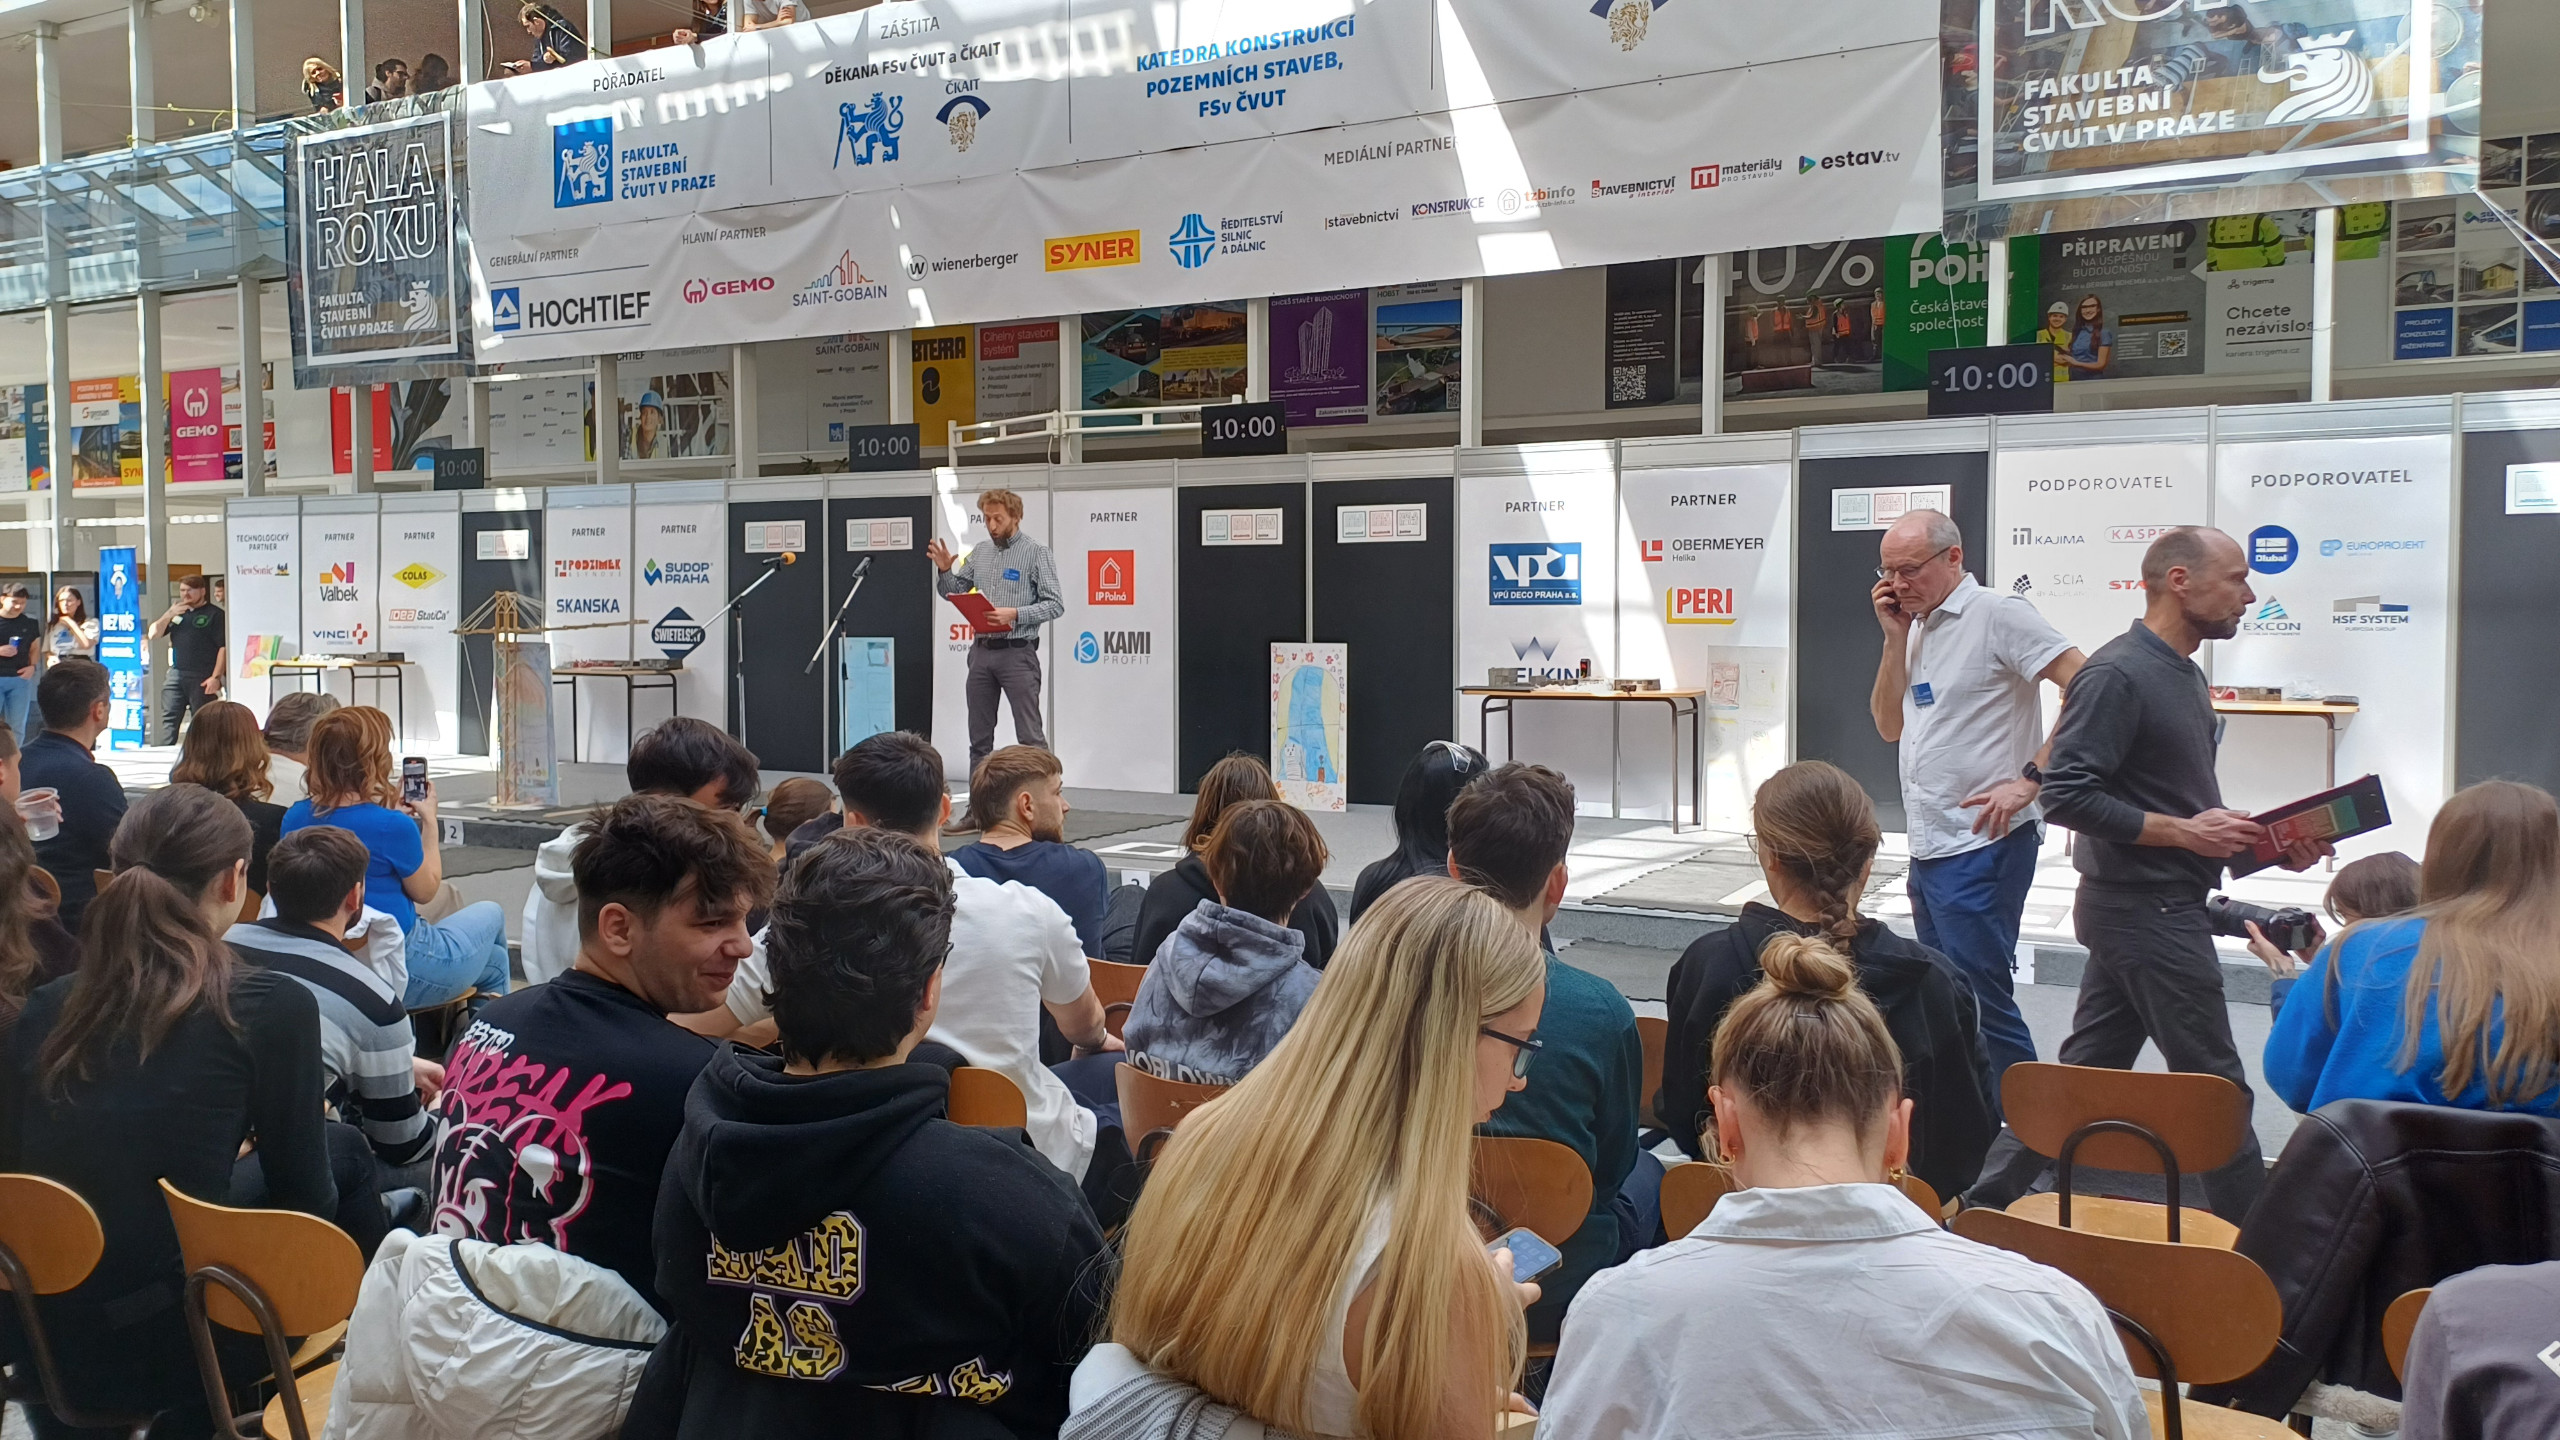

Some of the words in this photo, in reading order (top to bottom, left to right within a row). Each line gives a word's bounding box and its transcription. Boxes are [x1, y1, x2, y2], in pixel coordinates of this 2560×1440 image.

[880, 16, 940, 40] ZÁŠTITA
[1137, 42, 1221, 72] KATEDRA
[1225, 15, 1356, 55] KONSTRUKCÍ
[825, 63, 879, 85] DĚKANA
[882, 59, 907, 75] FSv
[910, 49, 946, 70] ČVUT
[949, 53, 957, 63] a
[960, 42, 1001, 62] ČKAIT
[593, 66, 666, 92] POŘADATEL
[1147, 64, 1258, 98] POZEMNÍCH
[1264, 51, 1343, 79] STAVEB,
[945, 77, 980, 95] ČKAIT
[2024, 65, 2153, 101] FAKULTA
[1199, 99, 1231, 117] FSv
[1235, 89, 1286, 112] ČVUT
[2023, 84, 2172, 127] STAVEBNÍ
[2022, 124, 2099, 153] ČVUT
[2105, 124, 2126, 145] V
[2135, 109, 2236, 138] PRAZE
[621, 143, 678, 164] FAKULTA
[1324, 141, 1392, 166] MEDIÁLNÍ
[1821, 149, 1900, 170] estav.tv
[621, 158, 687, 182] STAVEBNÍ
[1722, 158, 1783, 175] materiály
[315, 142, 434, 212] HALA
[621, 180, 656, 200] ČVUT
[660, 180, 669, 194] V
[672, 174, 716, 193] PRAZE
[1524, 186, 1575, 202] tzbinfo
[1592, 176, 1676, 198] STAVEBNICTVÍ
[1412, 197, 1485, 216] KONSTRUKCE
[1220, 211, 1283, 231] ŘEDITELSTVÍ
[1328, 208, 1400, 228] stavebnictví
[316, 202, 436, 270] ROKU
[682, 229, 718, 245] HLAVNÍ
[720, 226, 766, 242] PARTNER
[1221, 230, 1252, 243] SILNIC
[1050, 237, 1134, 265] SYNER
[1221, 245, 1228, 255] A
[1230, 240, 1266, 253] DÁLNIC
[489, 249, 539, 268] GENERÁLNÍ
[539, 248, 579, 262] PARTNER
[932, 252, 1019, 273] wienerberger
[2081, 258, 2096, 267] NA
[1909, 254, 2014, 289] POH
[2073, 263, 2149, 278] BUDOUCNOST
[711, 276, 775, 296] GEMO
[2242, 277, 2274, 286] trigema
[319, 292, 364, 308] FAKULTA
[793, 285, 887, 307] SAINT-GOBAIN
[1271, 297, 1291, 307] CHCEŠ
[319, 304, 371, 324] STAVEBNÍ
[529, 291, 651, 328] HOCHTIEF
[1910, 299, 1949, 314] Česká
[2227, 305, 2291, 320] Chcete
[1910, 315, 1984, 333] společnost
[2226, 320, 2314, 337] nezávislos
[2404, 318, 2442, 326] PROJEKTY
[321, 323, 347, 340] ČVUT
[349, 324, 356, 336] V
[359, 320, 394, 335] PRAZE
[983, 330, 1015, 343] Cihelný
[1017, 327, 1054, 340] stavební
[616, 351, 645, 361] CHTIEF
[815, 342, 880, 356] SAINT-GOBAIN
[983, 345, 1015, 356] systém
[1944, 361, 2038, 393] 10:00
[176, 425, 218, 438] GEMO
[1211, 415, 1276, 441] 10:00
[857, 436, 911, 457] 10:00
[124, 468, 143, 478] SYN
[440, 459, 477, 477] 10:00
[2029, 475, 2173, 492] PODPOROVATEL
[2251, 469, 2412, 488] PODPOROVATEL
[1505, 500, 1565, 513] PARTNER
[1671, 493, 1736, 506] PARTNER
[970, 514, 985, 524] PA
[1090, 511, 1138, 523] PARTNER
[404, 532, 435, 541] PARTNER
[572, 527, 606, 537] PARTNER
[661, 524, 697, 534] PARTNER
[2112, 528, 2168, 540] KASPE
[236, 532, 289, 543] TECHNOLOGICKÝ
[324, 533, 355, 542] PARTNER
[1672, 538, 1764, 551] OBERMEYER
[2035, 535, 2085, 545] KAJIMA
[249, 543, 277, 551] PARTNER
[568, 559, 621, 571] PODZIMEK
[1672, 553, 1695, 562] Helika
[2255, 554, 2288, 563] Dlubal
[236, 565, 273, 576] ViewSonic
[665, 562, 709, 572] SUDOP
[402, 571, 427, 581] COLAS
[665, 574, 709, 584] PRAHA
[2054, 574, 2084, 584] SCIA
[2109, 580, 2147, 589] STA
[320, 585, 359, 602] Valbek
[1095, 592, 1104, 602] IP
[1105, 590, 1127, 602] Polná
[1493, 590, 1508, 599] VPÚ
[1511, 591, 1533, 599] DECO
[1535, 591, 1563, 599] PRAHA
[1677, 588, 1732, 614] PERI
[557, 598, 620, 613] SKANSKA
[2243, 622, 2300, 631] EXCON
[2333, 615, 2357, 624] HSF
[2360, 615, 2409, 624] SYSTEM
[313, 630, 349, 640] VINCI
[1104, 631, 1151, 654] KAMI
[949, 644, 970, 652] WOR
[1104, 655, 1151, 665] PROFIT
[1517, 668, 1580, 681] ELKIN
[449, 825, 457, 840] 2
